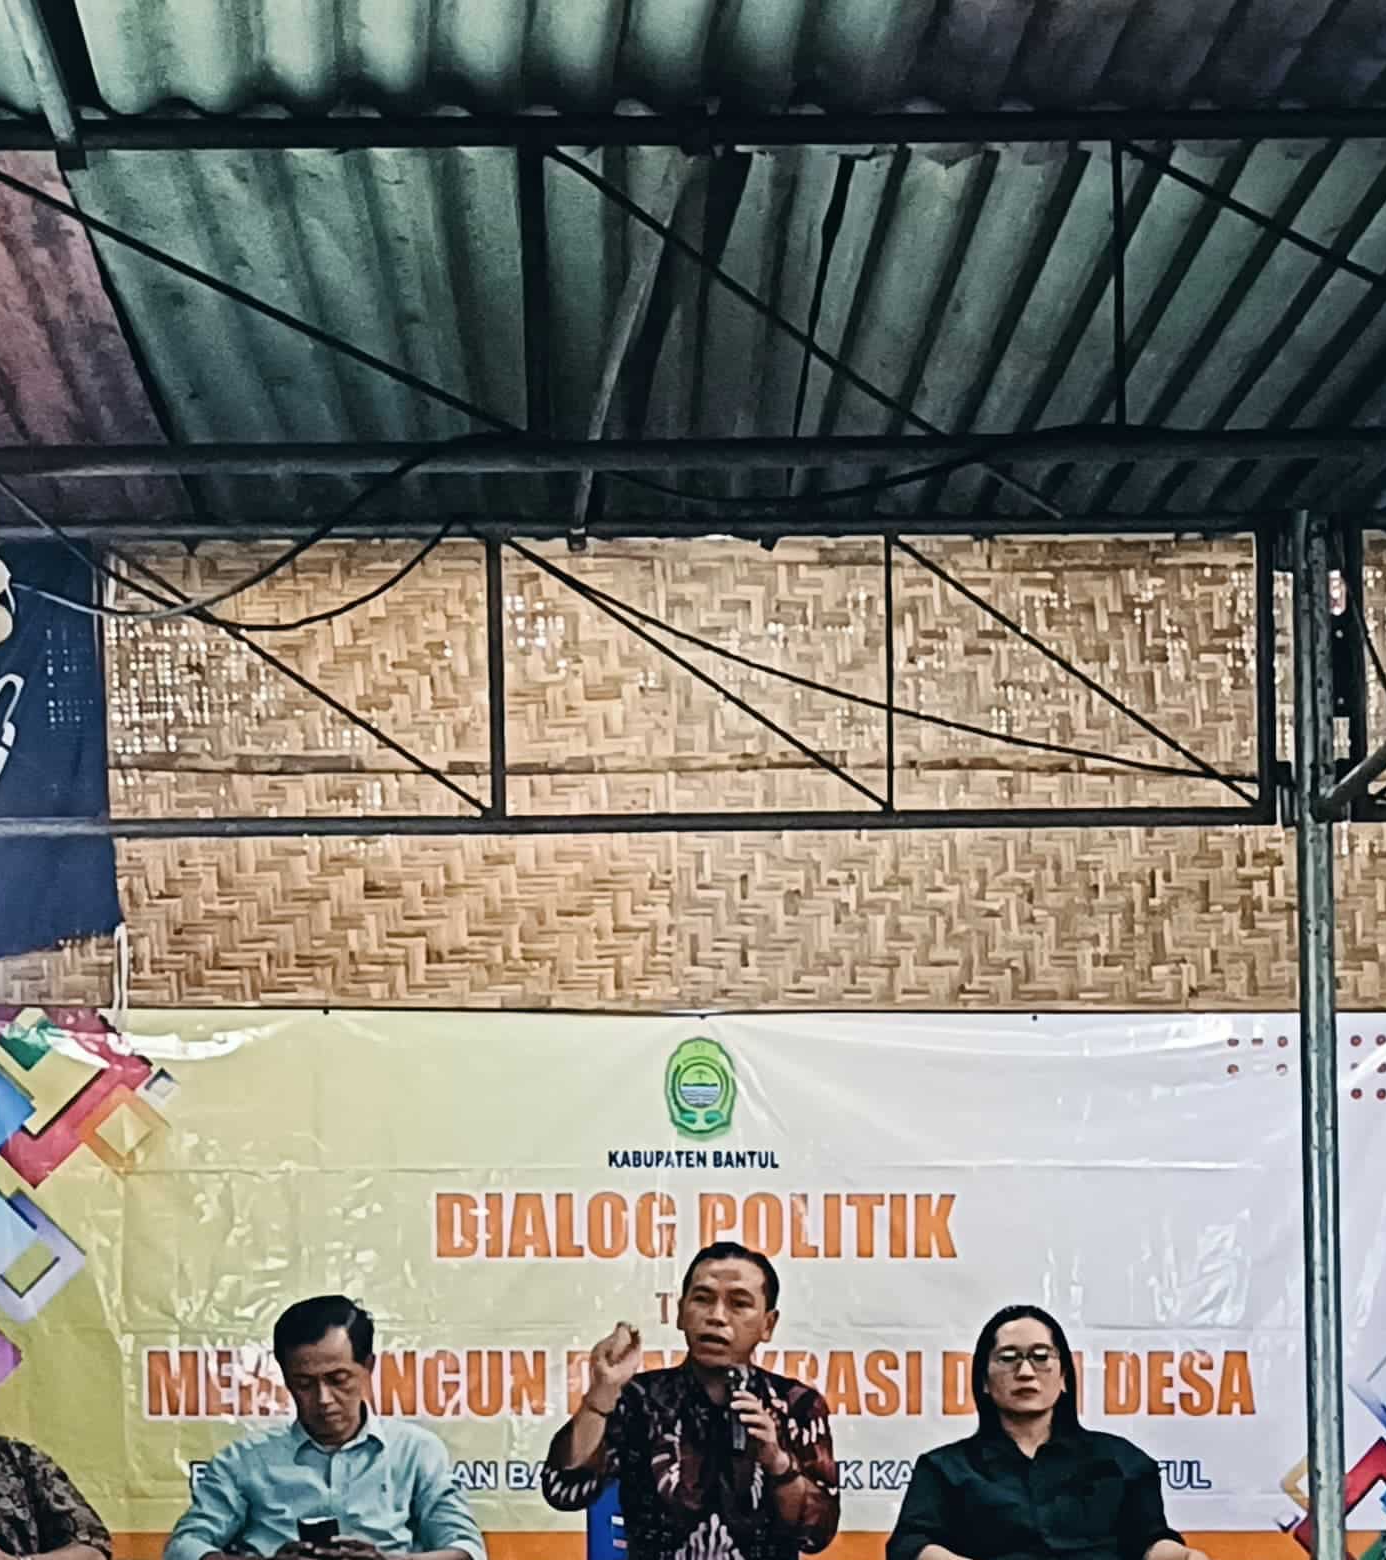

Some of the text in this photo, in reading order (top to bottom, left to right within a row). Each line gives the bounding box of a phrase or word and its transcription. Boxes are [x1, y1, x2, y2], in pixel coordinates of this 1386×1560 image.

[608, 1150, 779, 1169] KABUPATEN BANTUL
[435, 1192, 958, 1259] DIALOG POLITIK
[1103, 1349, 1256, 1417] DESA
